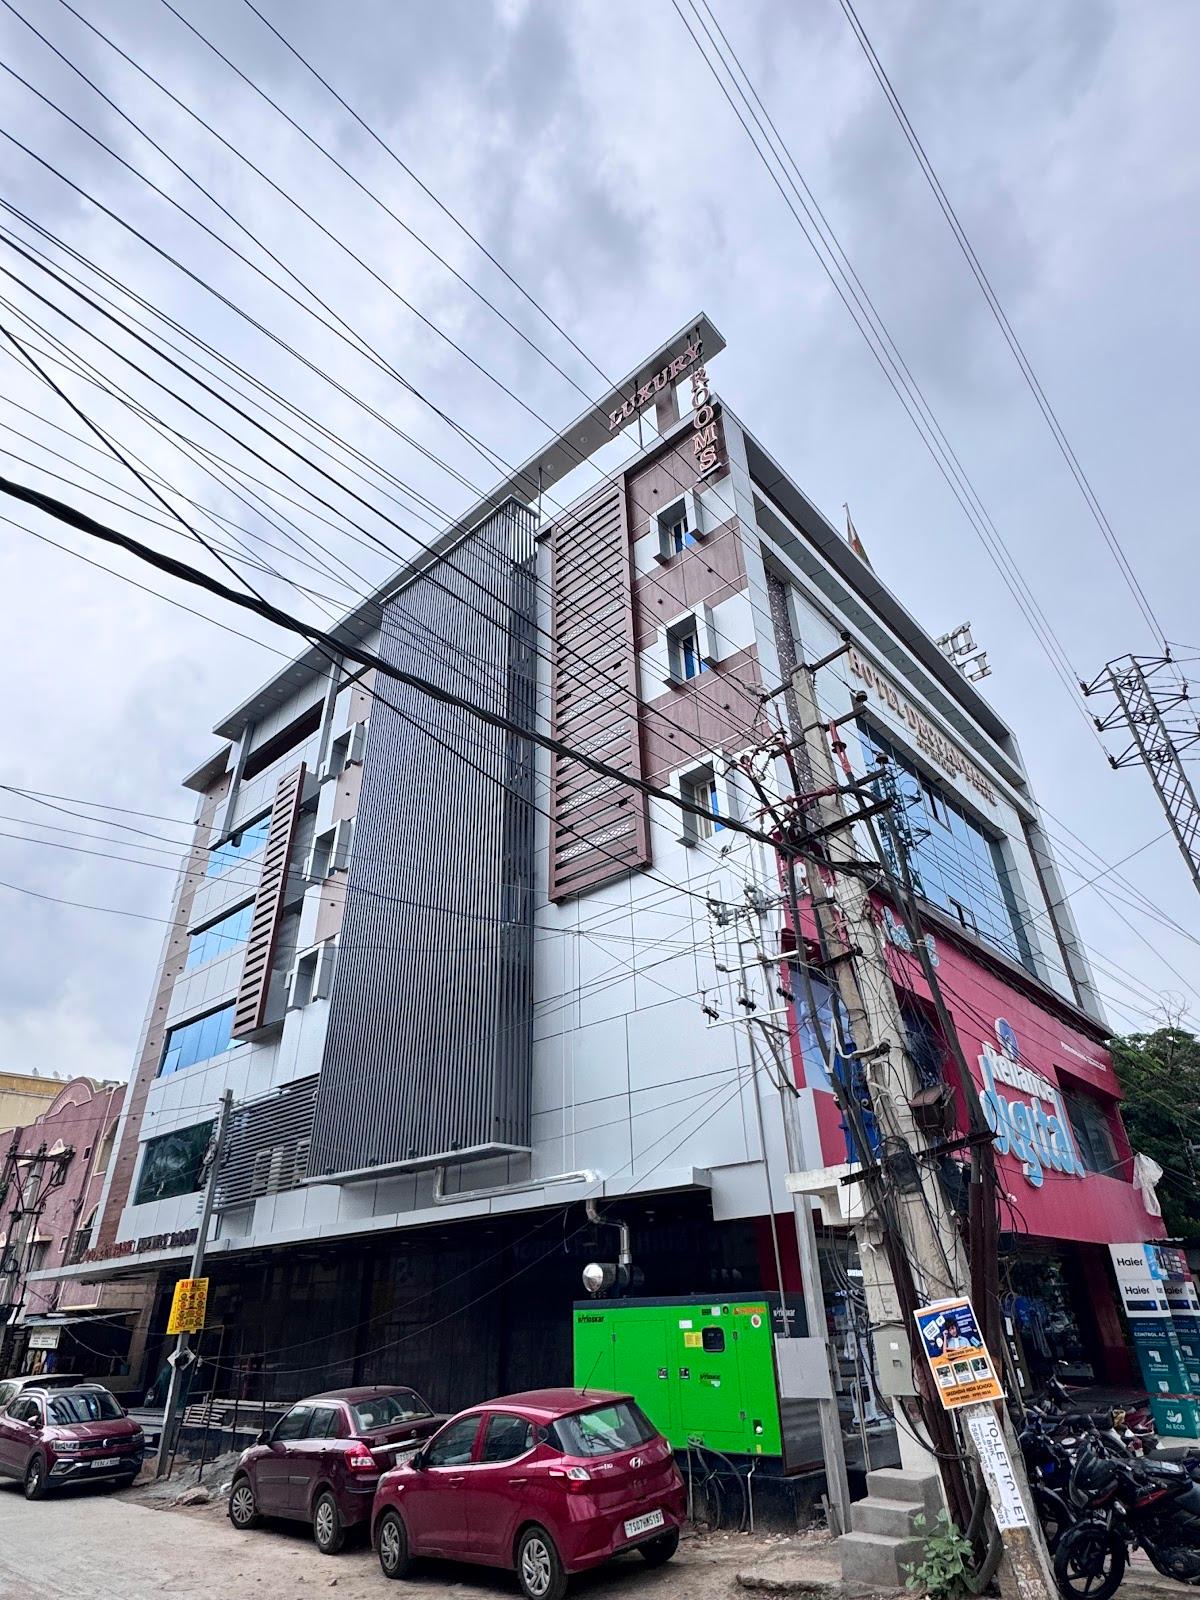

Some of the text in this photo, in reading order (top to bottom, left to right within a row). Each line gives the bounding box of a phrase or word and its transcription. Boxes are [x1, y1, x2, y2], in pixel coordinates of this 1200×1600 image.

[608, 339, 704, 431] LUXURY
[690, 366, 719, 473] ROOMS
[1117, 1257, 1143, 1266] Haier
[1124, 1286, 1150, 1295] Haier
[987, 1419, 1010, 1469] TO-LET
